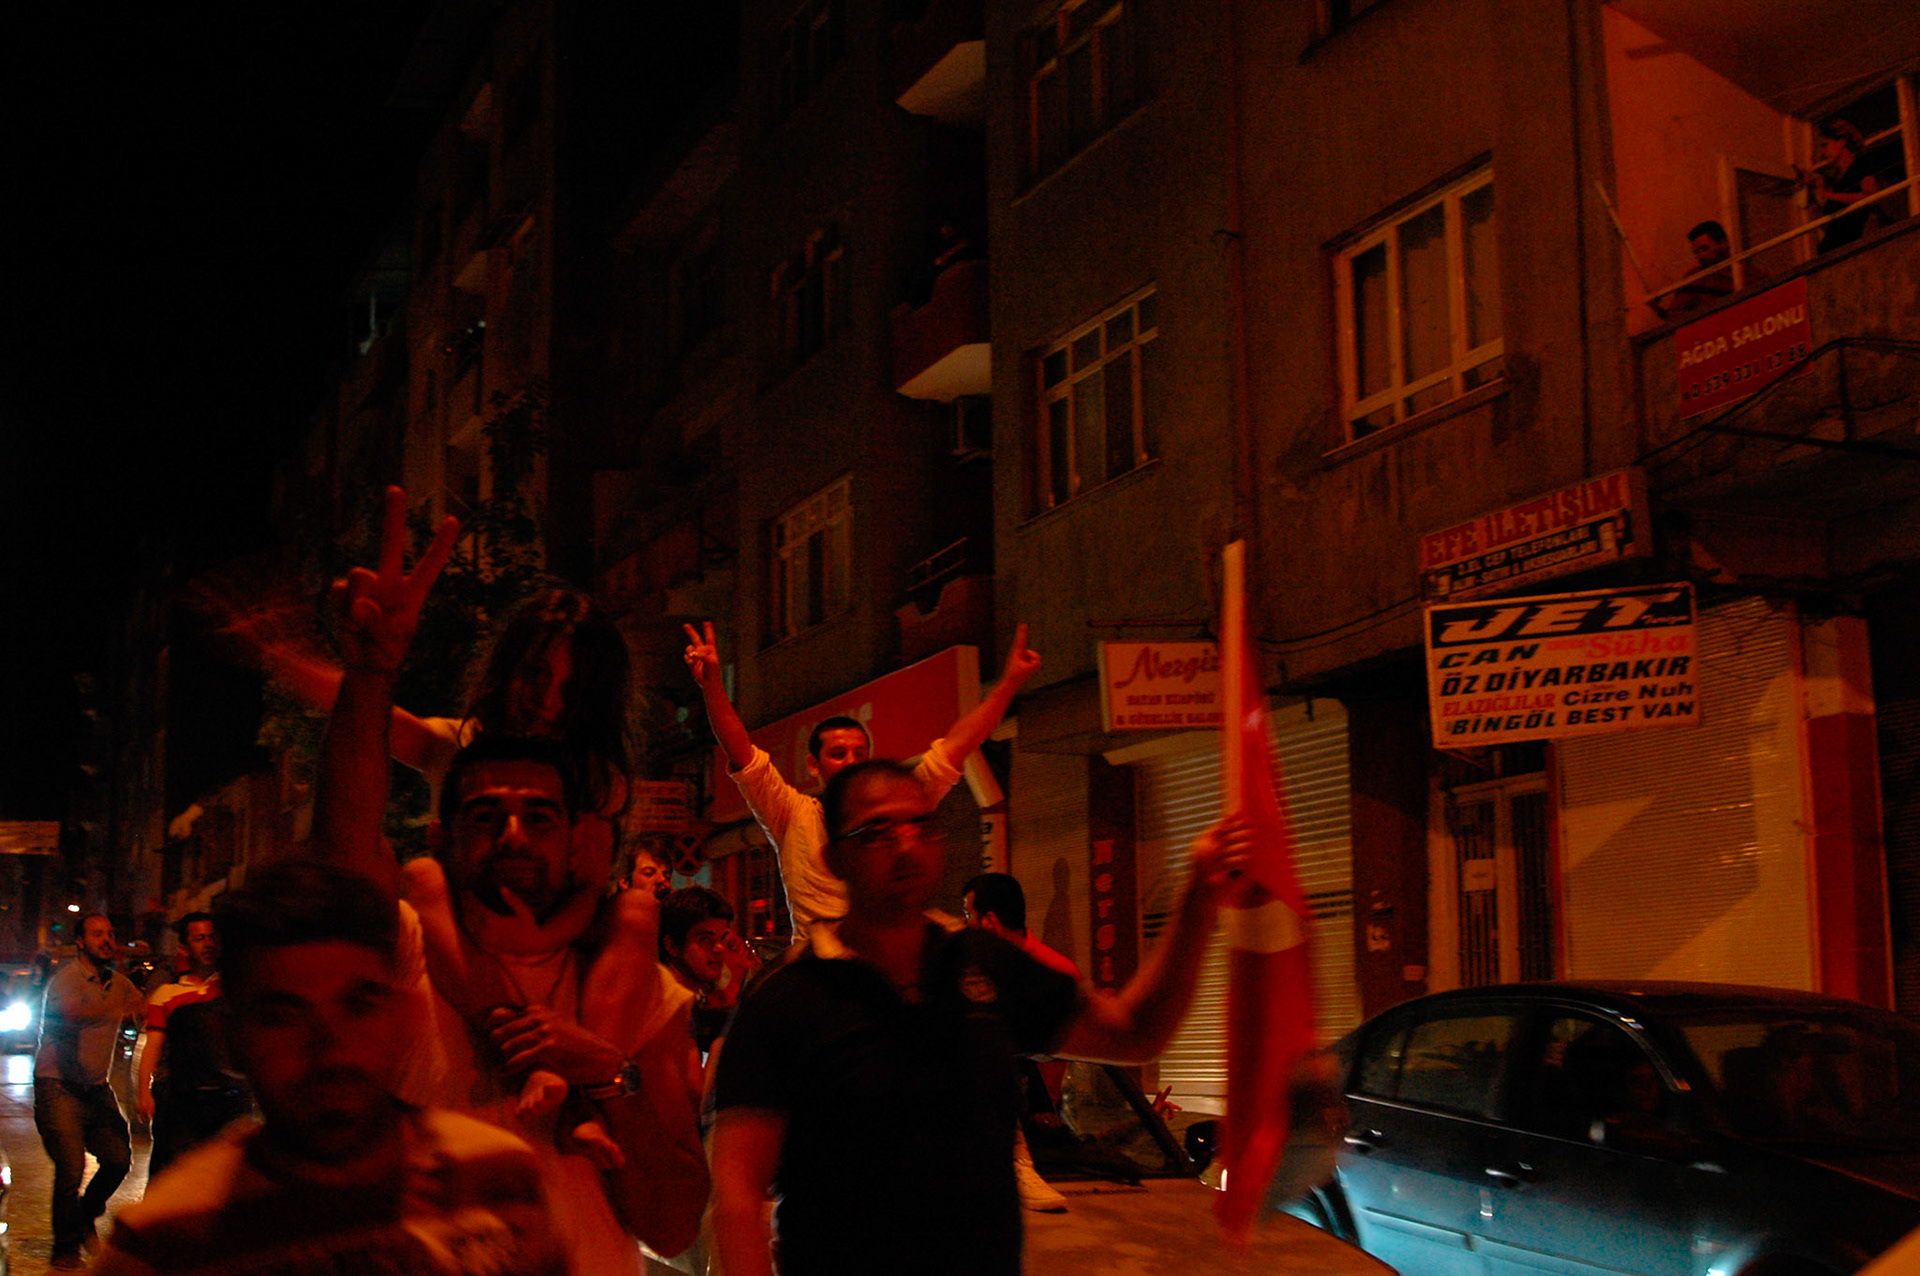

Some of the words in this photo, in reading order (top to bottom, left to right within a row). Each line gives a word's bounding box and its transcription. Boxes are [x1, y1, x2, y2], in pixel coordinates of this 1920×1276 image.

[1731, 304, 1806, 349] SALONU
[1424, 522, 1479, 567] EFE
[1438, 591, 1685, 644] JET
[1438, 643, 1540, 669] CAN
[1586, 631, 1690, 659] Süha
[1441, 671, 1480, 697] ÖZ
[1485, 656, 1691, 694] DİYARBAKIR
[1564, 687, 1630, 706] Cizre
[1639, 682, 1694, 700] Nuh
[1451, 709, 1556, 736] BİNGÖL
[1566, 705, 1634, 726] BEST
[1643, 701, 1695, 719] VAN
